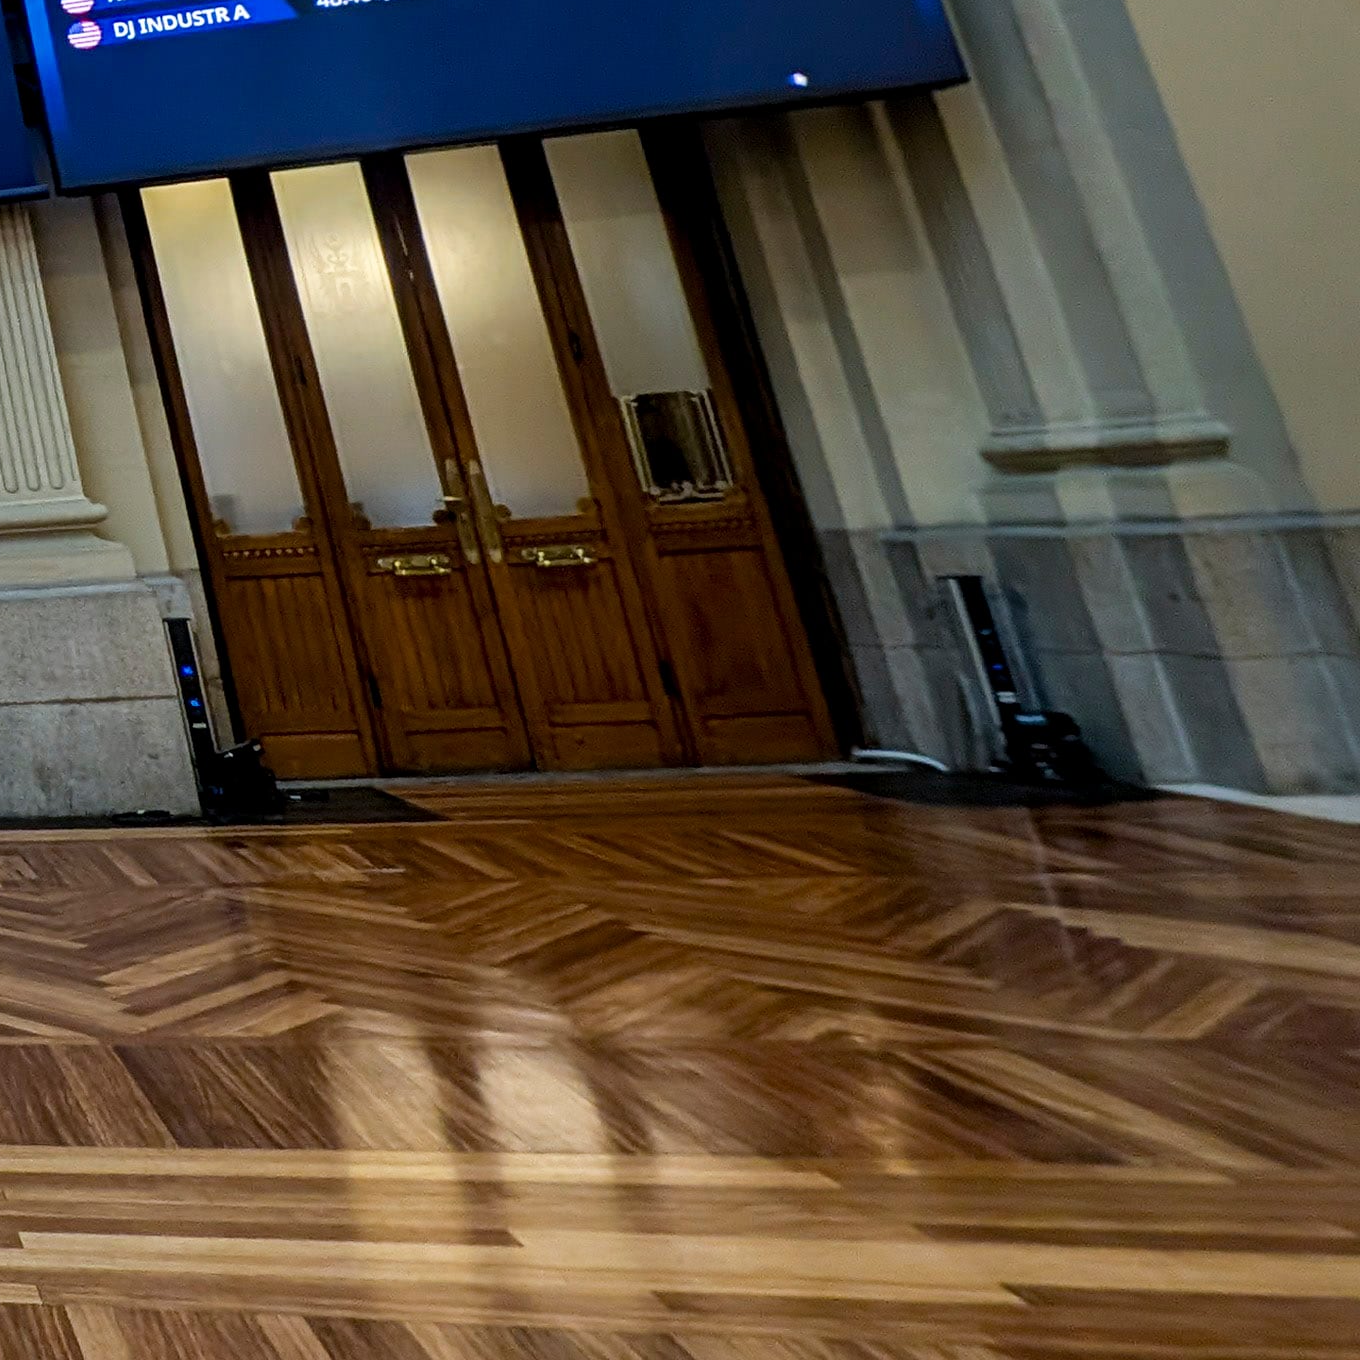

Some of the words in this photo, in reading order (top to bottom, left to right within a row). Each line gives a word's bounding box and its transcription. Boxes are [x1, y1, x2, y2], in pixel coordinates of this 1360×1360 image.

[113, 21, 135, 41] DJ
[138, 8, 230, 35] INDUSTR
[233, 4, 251, 22] A
